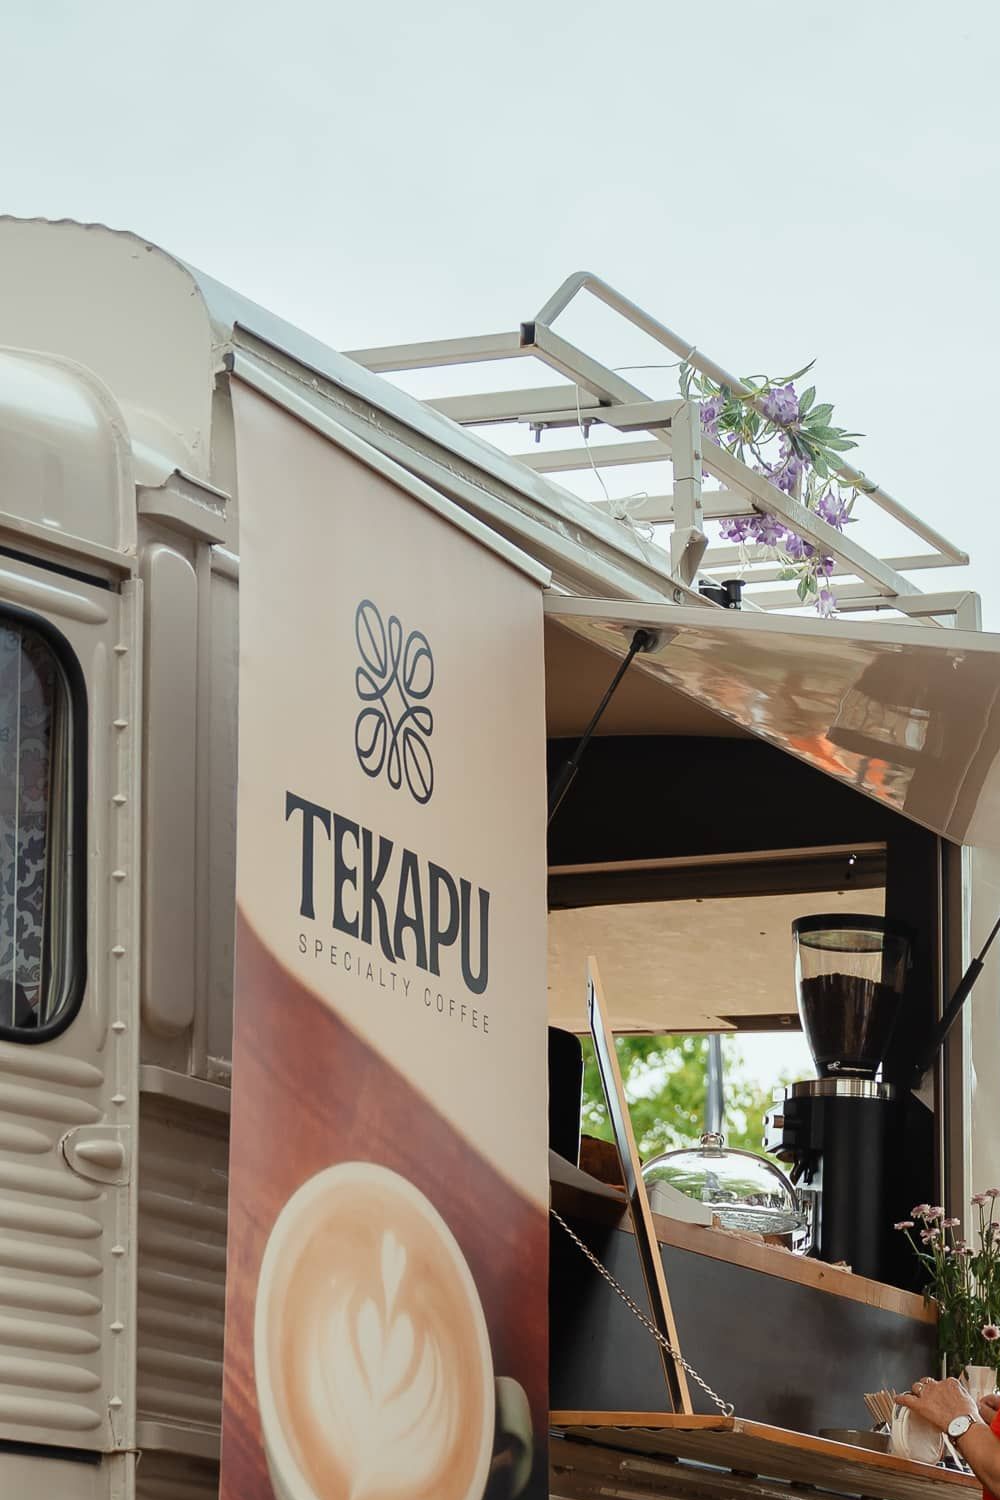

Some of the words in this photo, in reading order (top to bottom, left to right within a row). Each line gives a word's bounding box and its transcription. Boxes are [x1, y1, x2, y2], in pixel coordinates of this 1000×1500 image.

[285, 790, 490, 995] TEKAPU
[298, 933, 411, 997] SPECIALTY
[424, 987, 489, 1034] COFFEE
